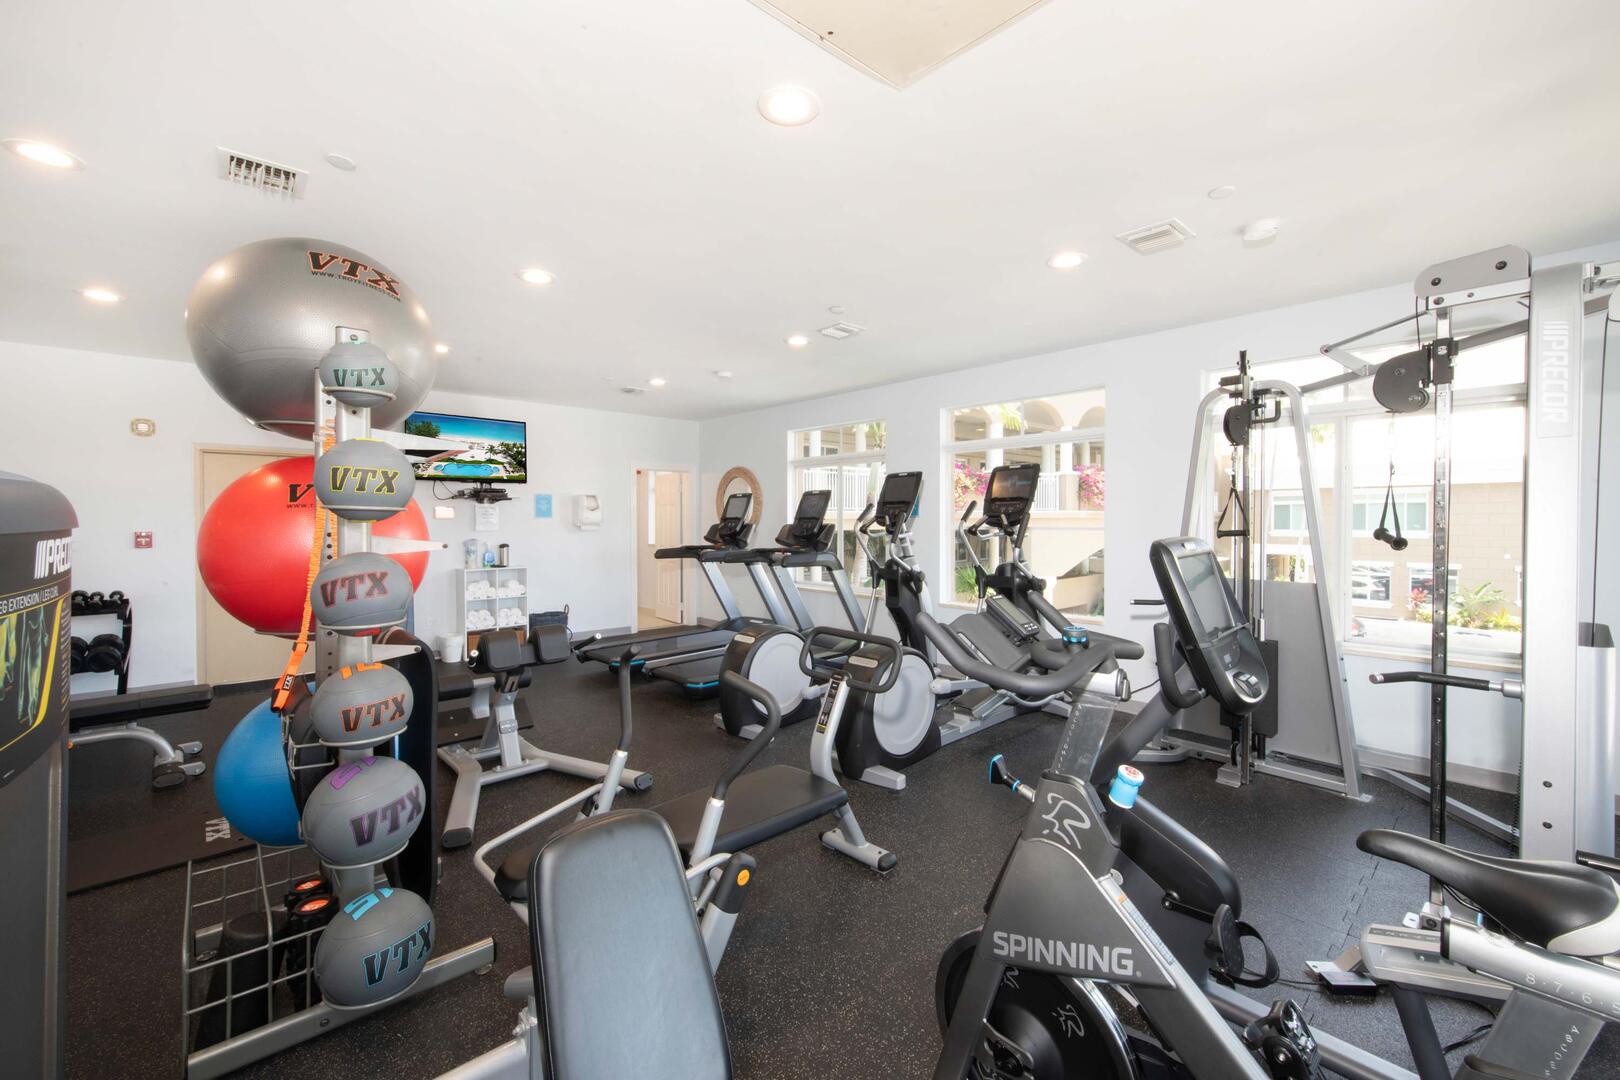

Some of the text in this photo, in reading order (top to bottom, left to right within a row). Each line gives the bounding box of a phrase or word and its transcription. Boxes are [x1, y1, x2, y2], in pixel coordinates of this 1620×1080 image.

[307, 250, 400, 297] VTX
[333, 367, 386, 387] VTX
[1542, 334, 1569, 423] PRECOR
[329, 464, 400, 495] VTX
[8, 592, 40, 612] EXTENSION
[319, 571, 389, 609] VTX
[340, 694, 406, 733] VTX
[350, 784, 423, 848] VTX
[363, 920, 432, 987] VTX
[993, 930, 1134, 977] SPINNING
